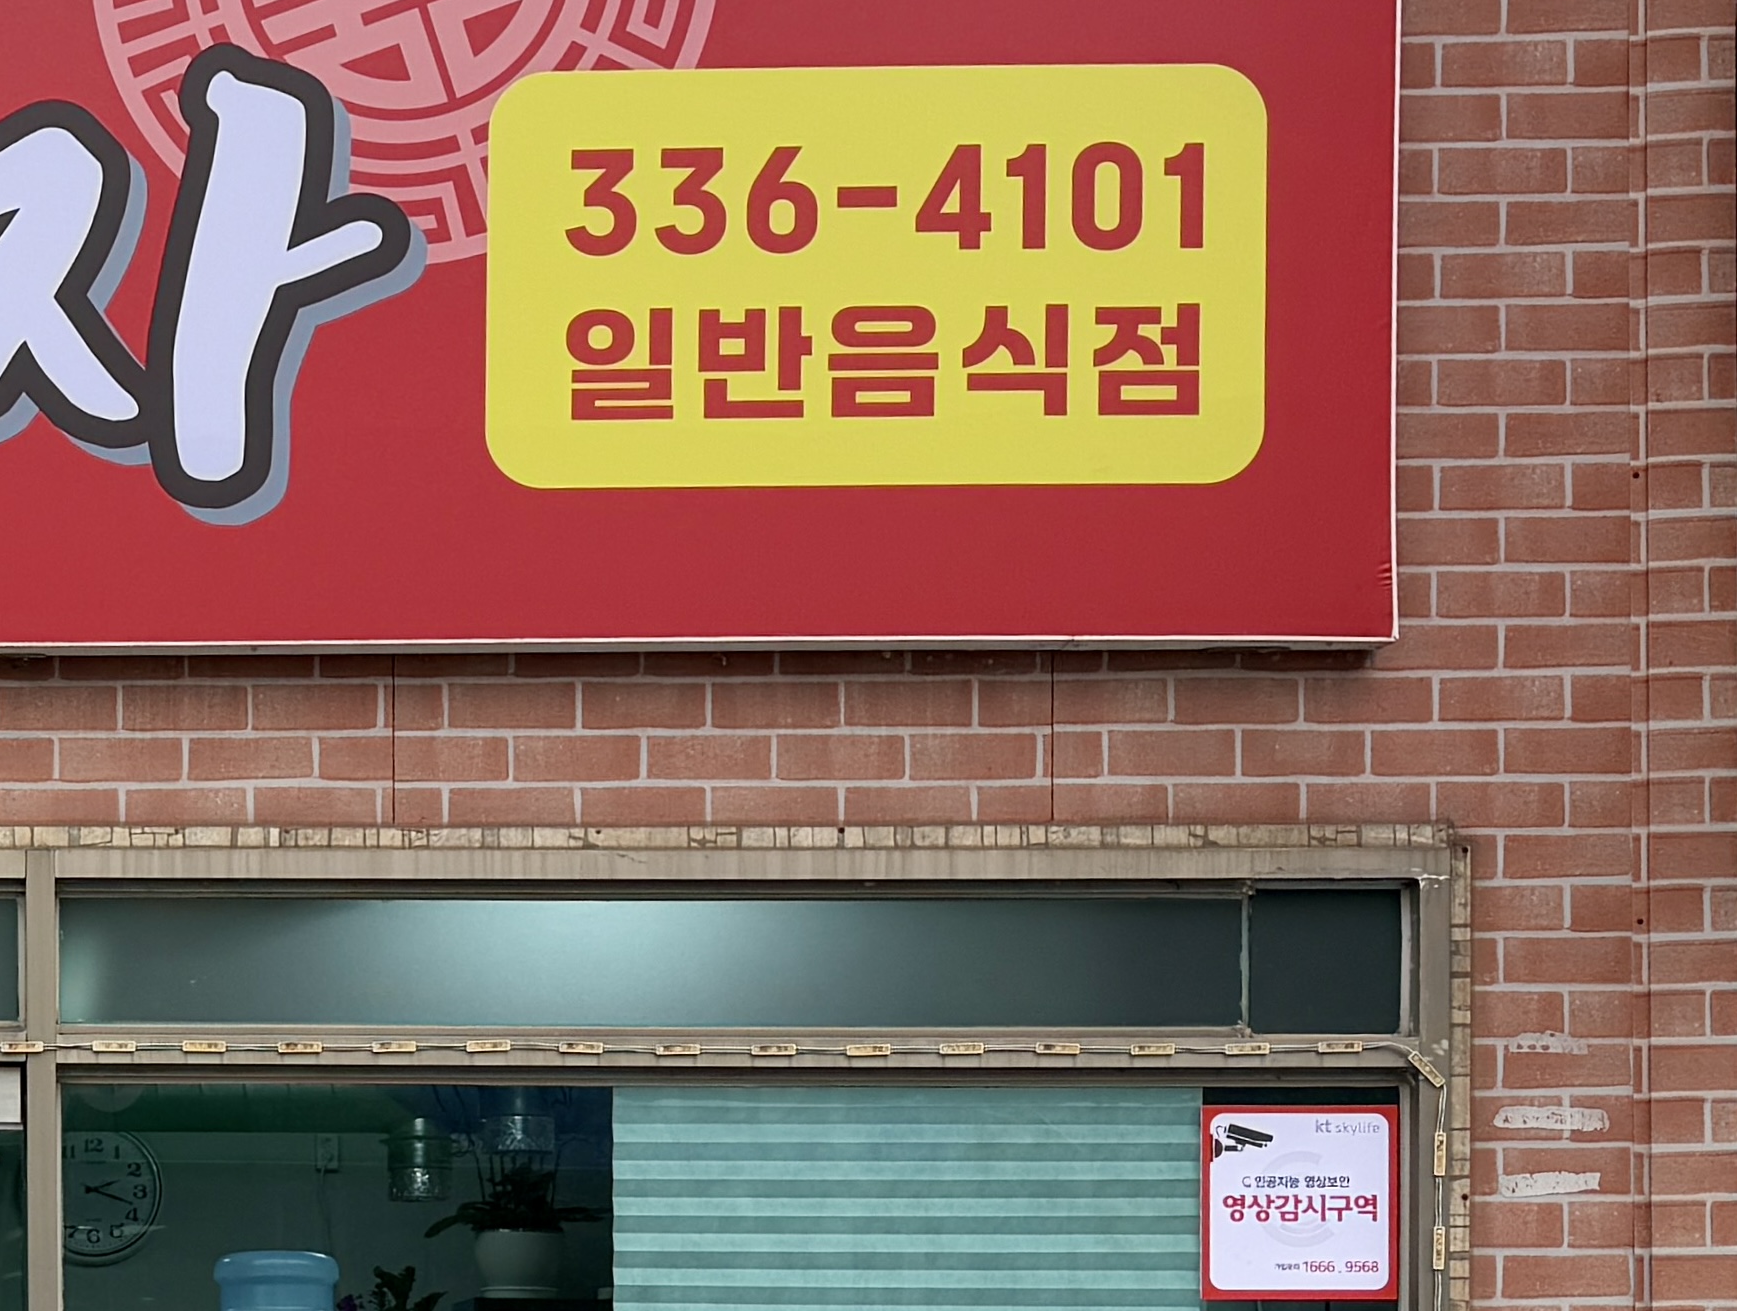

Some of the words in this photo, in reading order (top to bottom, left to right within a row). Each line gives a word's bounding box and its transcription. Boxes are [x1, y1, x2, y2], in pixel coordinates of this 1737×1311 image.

[564, 140, 1206, 258] 336-4101
[565, 301, 1202, 422] 일반음식점
[1315, 1118, 1332, 1134] kt
[1335, 1120, 1381, 1136] skylife
[84, 1138, 104, 1153] 12
[113, 1144, 120, 1159] 1
[127, 1161, 142, 1177] 2
[132, 1183, 148, 1199] 3
[126, 1207, 139, 1222] 4
[1222, 1194, 1378, 1223] 영상감시구역
[86, 1228, 101, 1244] 6
[109, 1222, 125, 1239] 5
